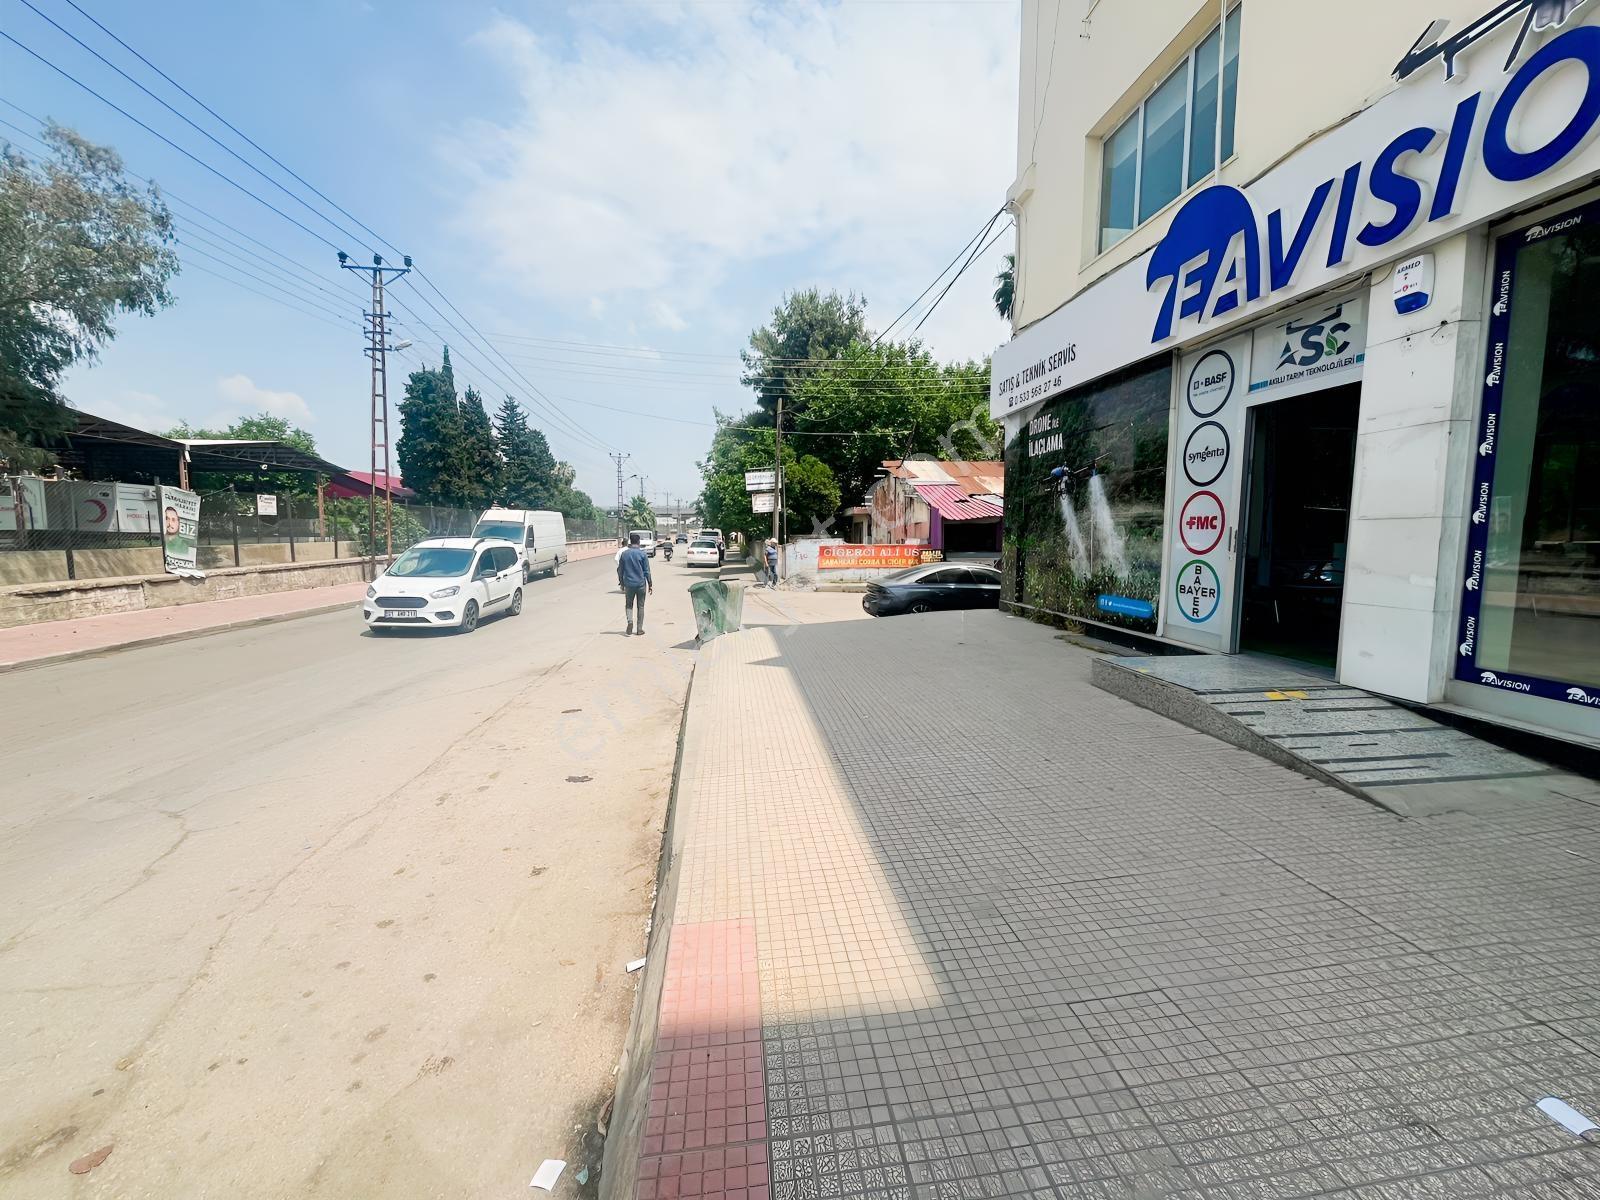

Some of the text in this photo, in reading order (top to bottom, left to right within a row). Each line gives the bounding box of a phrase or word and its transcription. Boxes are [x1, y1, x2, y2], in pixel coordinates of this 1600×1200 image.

[998, 342, 1076, 396] SATIŞ & TEKNİK SERVİS
[1204, 371, 1227, 387] BASF
[1029, 413, 1052, 437] DRONE
[1188, 446, 1225, 463] syngenta
[1186, 515, 1218, 530] FMC
[1179, 584, 1216, 599] BAYER
[1191, 565, 1203, 618] BAYER
[1480, 671, 1531, 692] TEAVISION
